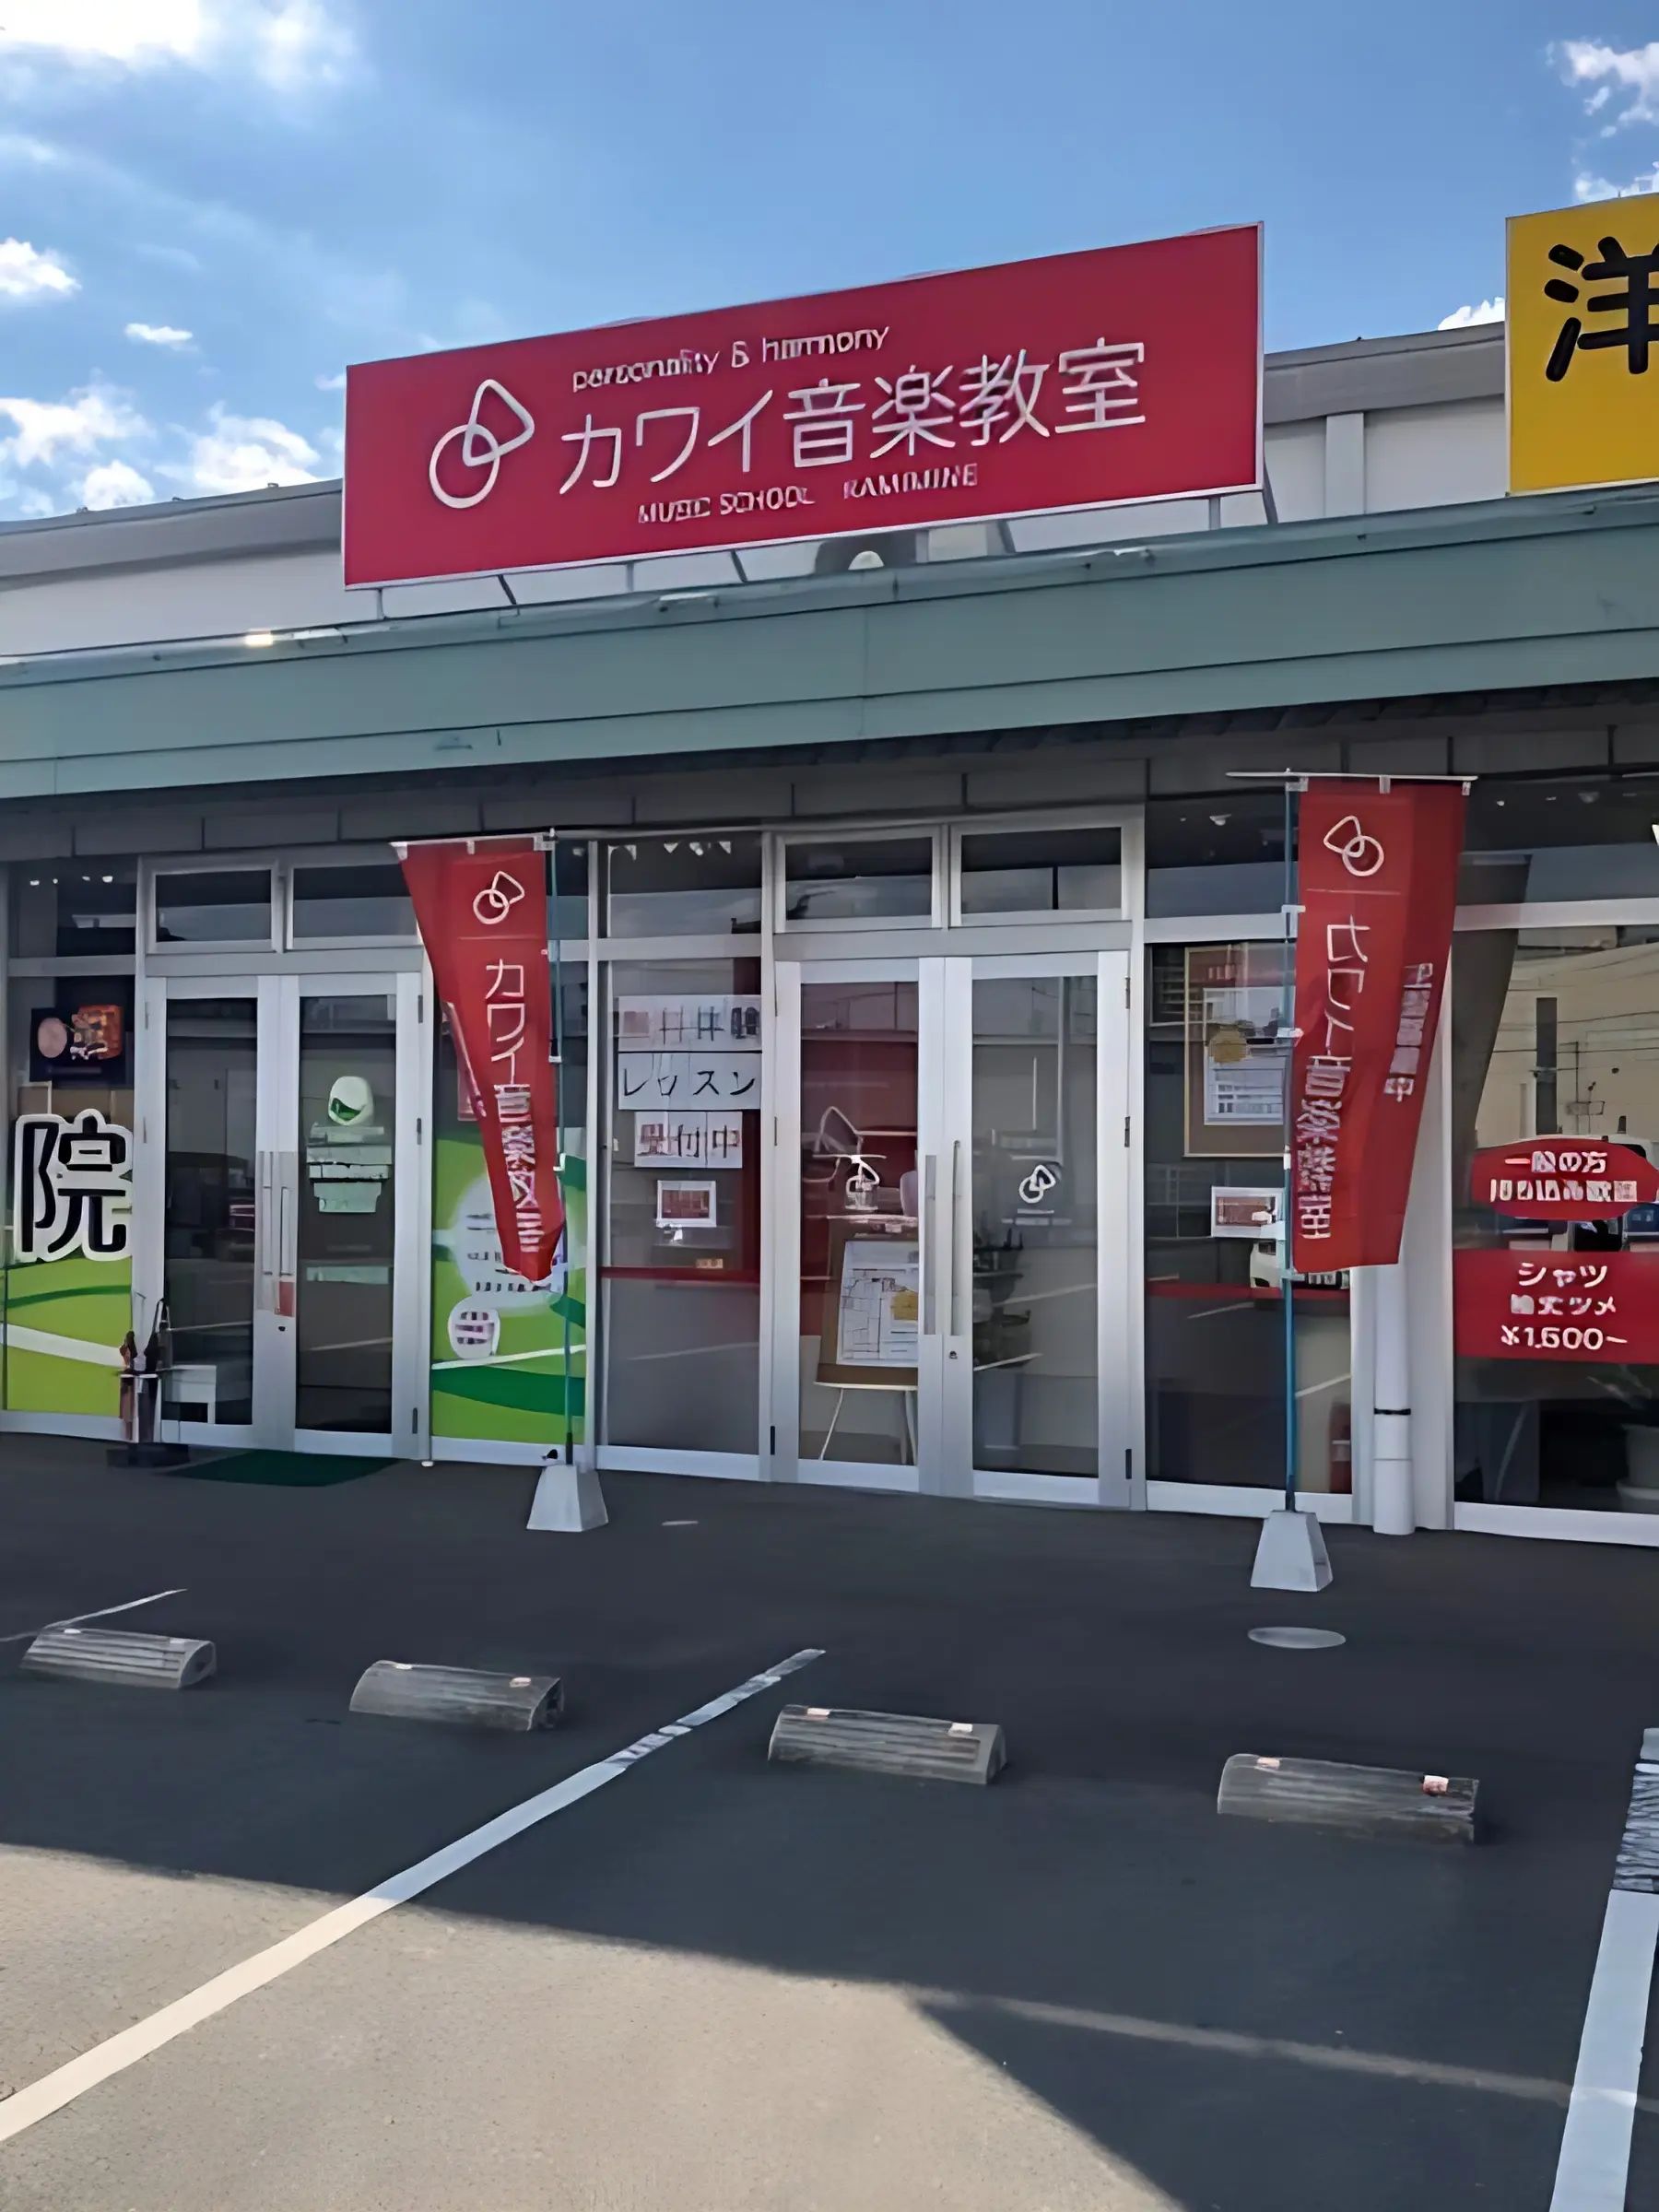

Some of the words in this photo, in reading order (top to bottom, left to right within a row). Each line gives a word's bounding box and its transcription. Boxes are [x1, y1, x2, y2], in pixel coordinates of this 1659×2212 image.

[1544, 236, 1659, 382] 洋
[559, 336, 1146, 495] カワイ音楽教室
[20, 1113, 129, 1253] 院
[1510, 1293, 1617, 1316] 丈ツメ
[1518, 1262, 1608, 1288] シャツ
